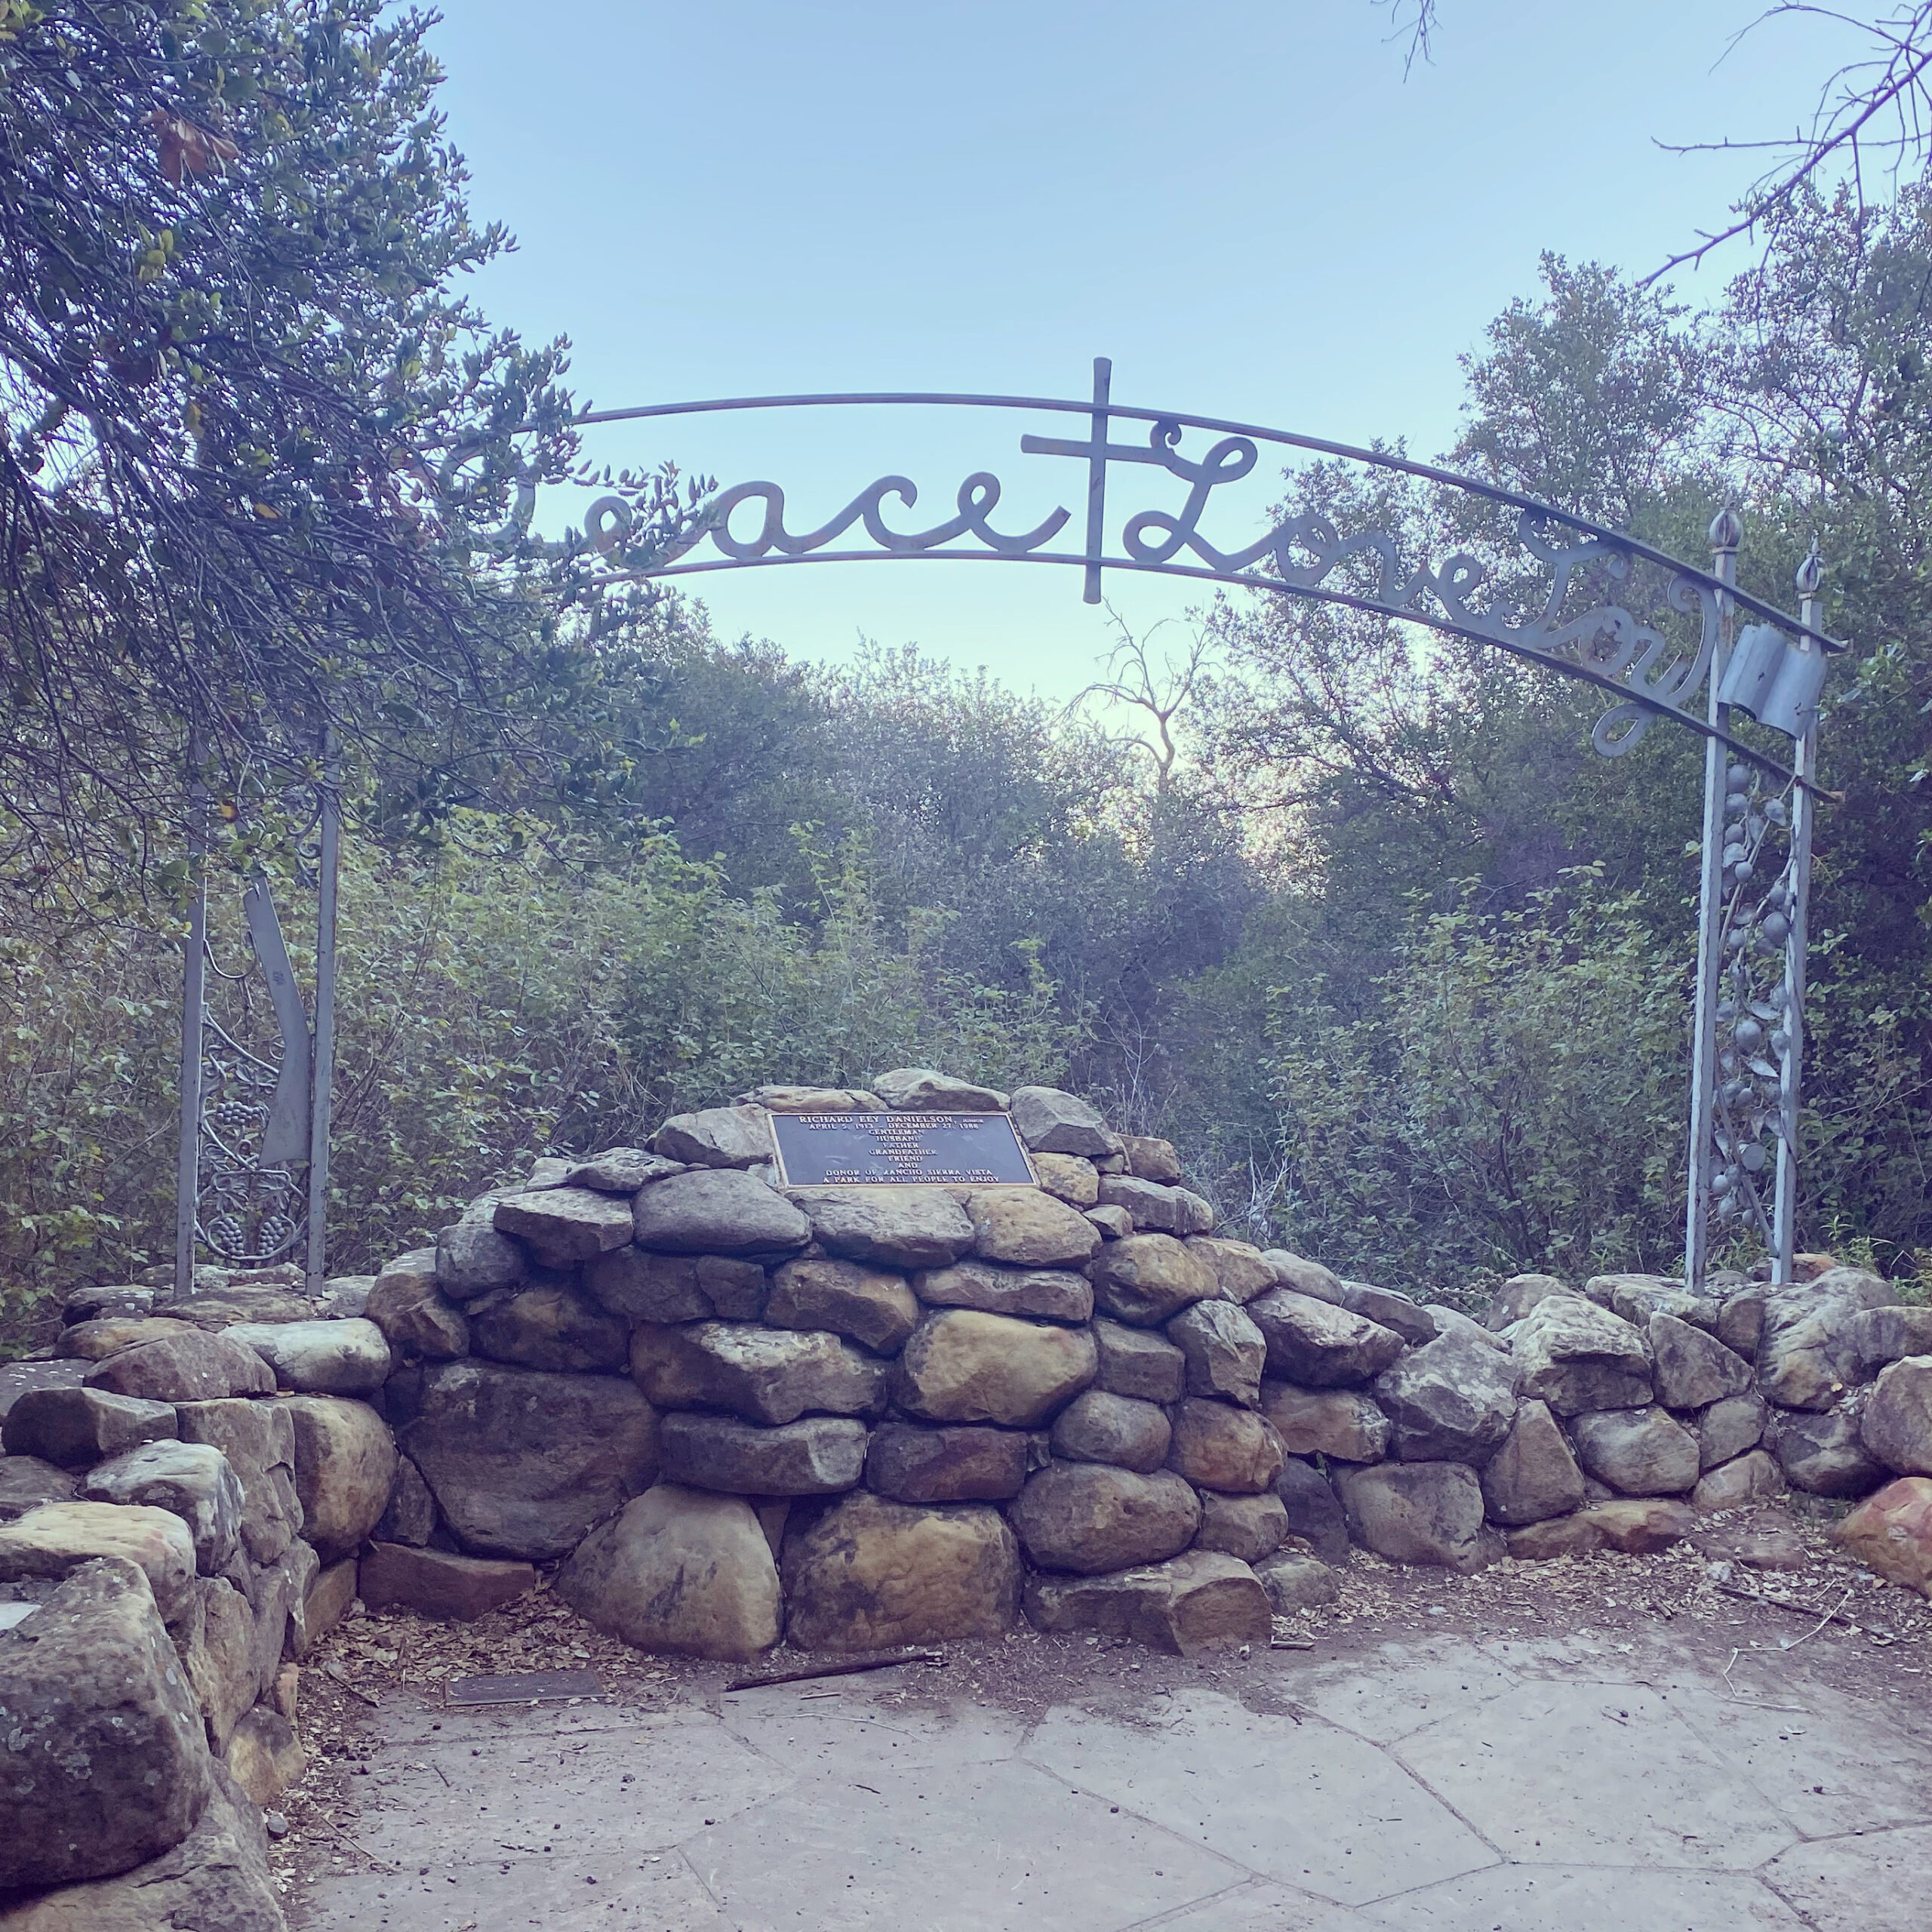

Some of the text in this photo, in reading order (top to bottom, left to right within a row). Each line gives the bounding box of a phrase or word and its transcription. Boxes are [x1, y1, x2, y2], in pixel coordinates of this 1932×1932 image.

[439, 417, 1721, 756] eace Love Joy
[798, 1115, 854, 1124] RICHARD
[885, 1115, 957, 1124] DANIELSON,
